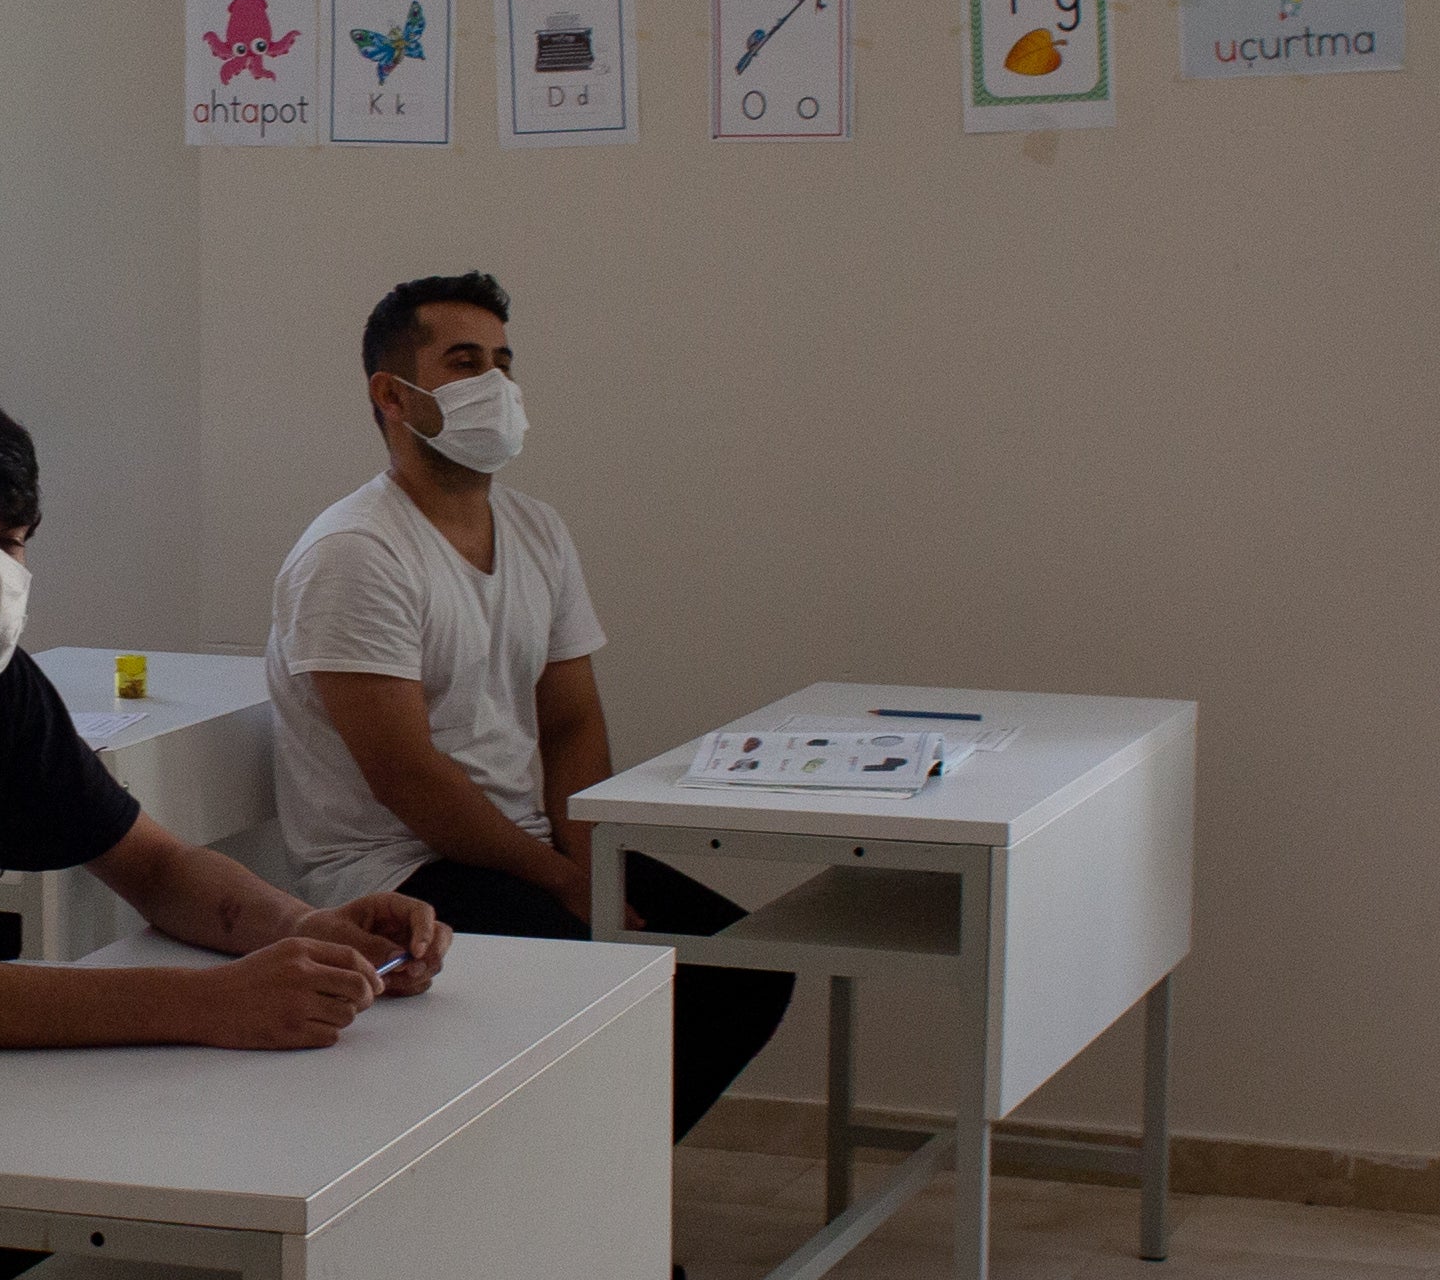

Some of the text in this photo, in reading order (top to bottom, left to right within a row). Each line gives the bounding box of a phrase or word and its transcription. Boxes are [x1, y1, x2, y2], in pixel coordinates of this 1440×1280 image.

[1214, 25, 1377, 69] uçurtma
[194, 90, 308, 137] ahtapot
[548, 85, 566, 108] D
